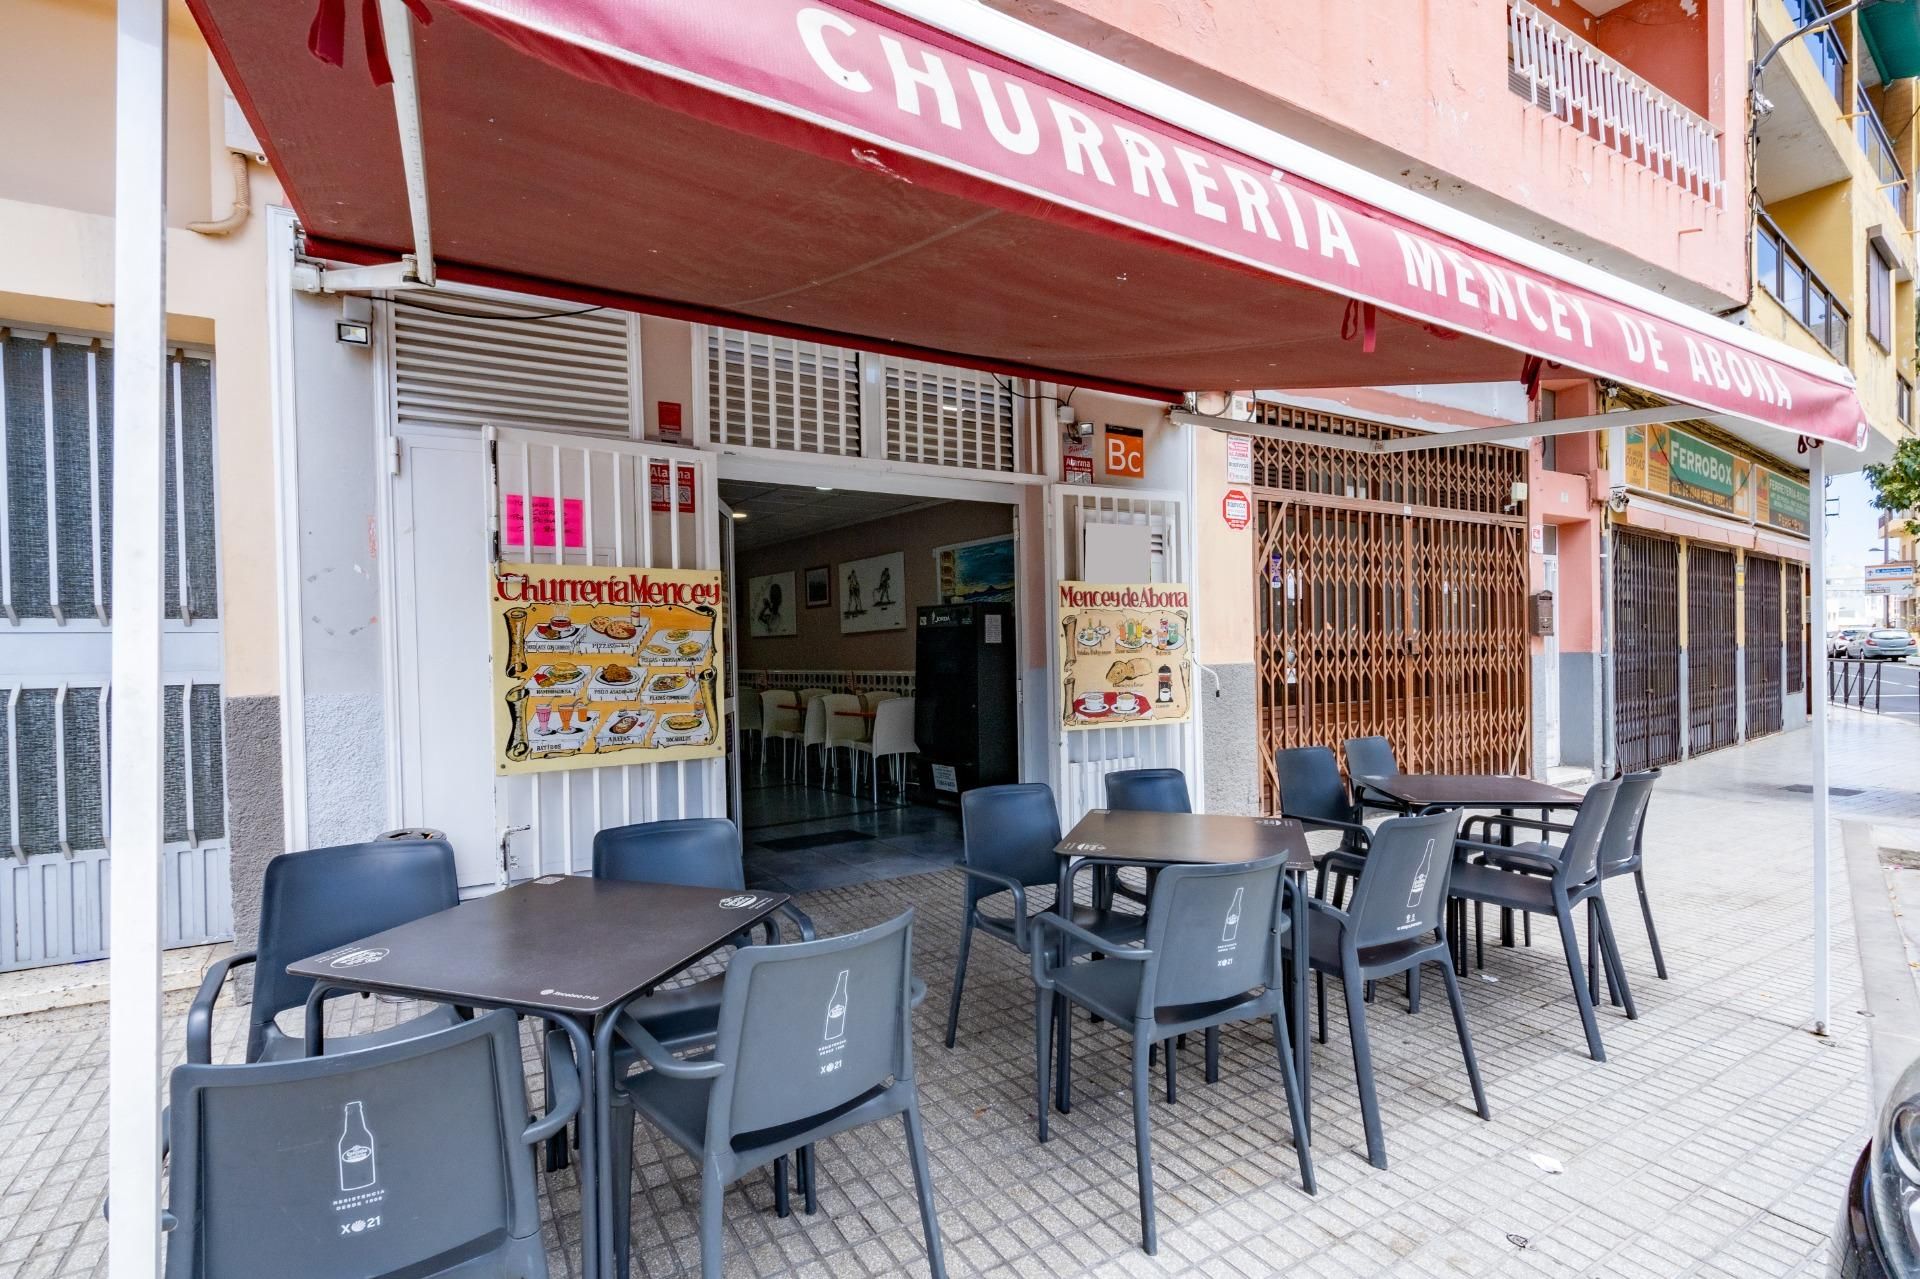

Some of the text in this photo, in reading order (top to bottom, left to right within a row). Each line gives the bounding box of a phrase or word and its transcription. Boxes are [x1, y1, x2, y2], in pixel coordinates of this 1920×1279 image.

[796, 7, 1793, 410] CHURRERÍA MENCEY DE ABONA
[651, 466, 691, 480] Alama
[1108, 438, 1141, 473] Bc
